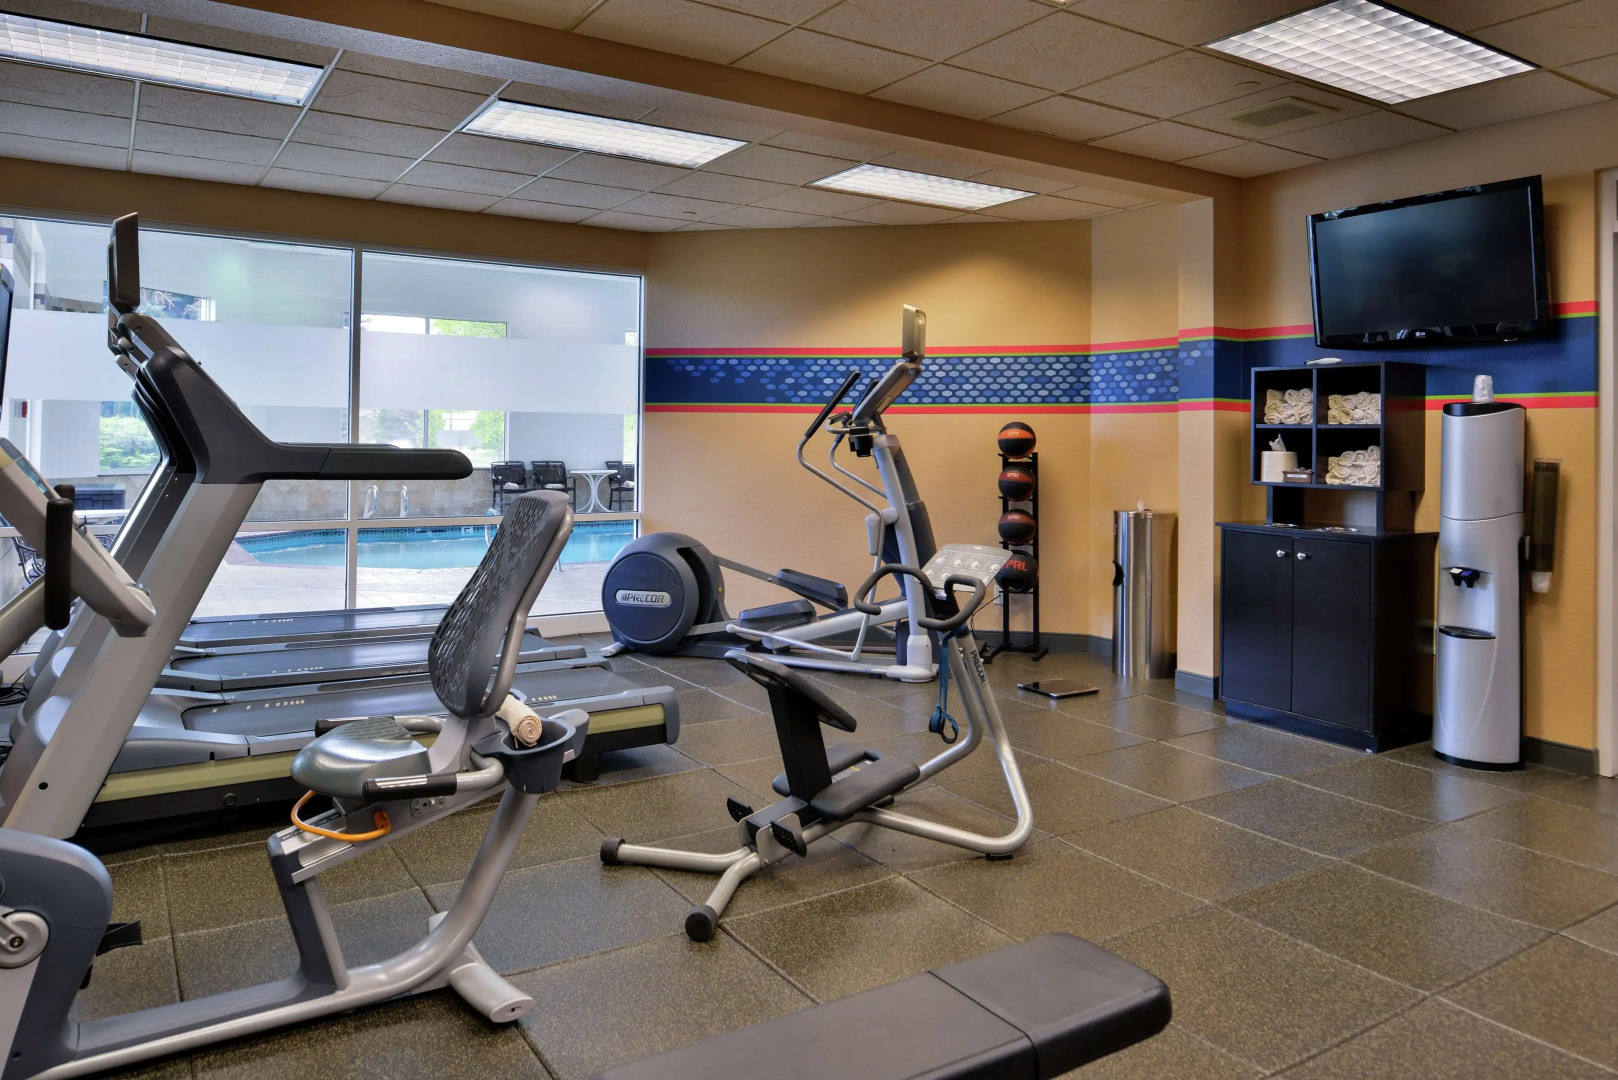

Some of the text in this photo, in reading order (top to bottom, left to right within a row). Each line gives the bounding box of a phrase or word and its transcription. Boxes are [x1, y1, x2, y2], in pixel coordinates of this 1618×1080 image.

[1004, 559, 1026, 571] PRI
[626, 592, 665, 603] PRECOR
[970, 650, 986, 684] PRECOR
